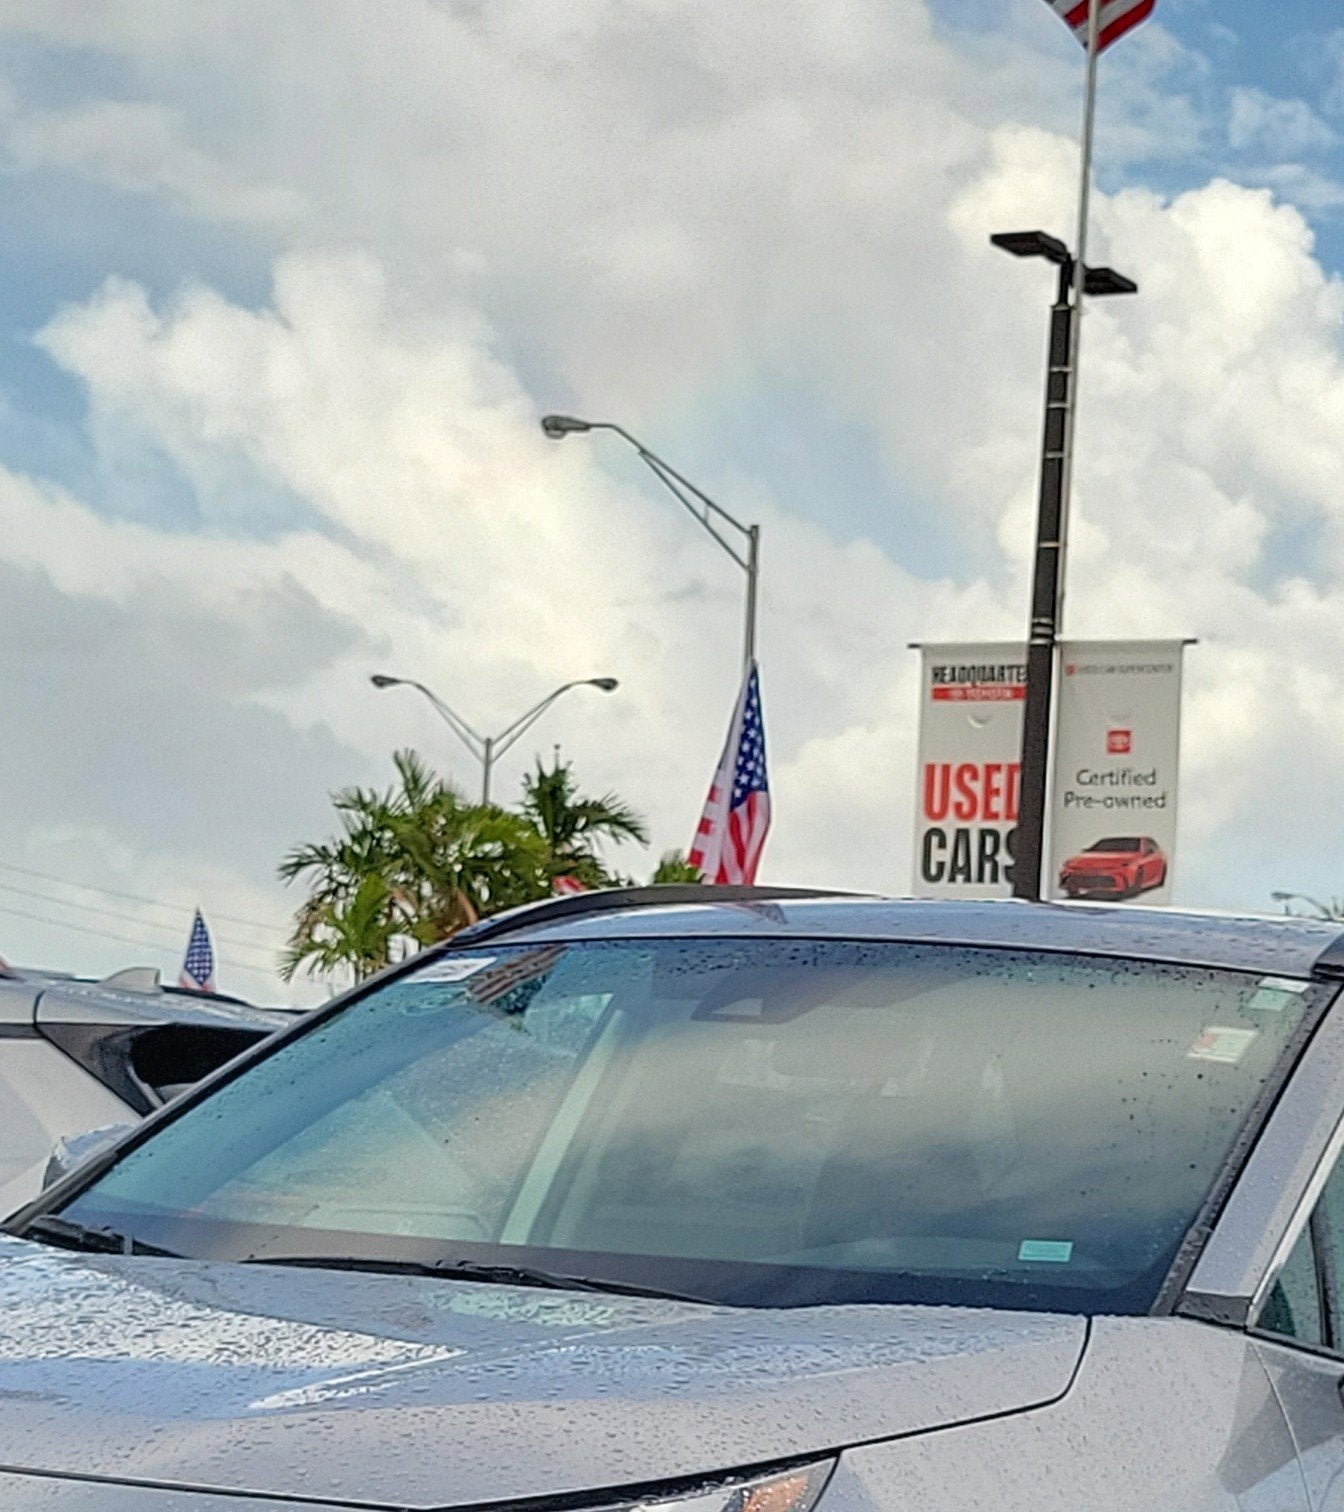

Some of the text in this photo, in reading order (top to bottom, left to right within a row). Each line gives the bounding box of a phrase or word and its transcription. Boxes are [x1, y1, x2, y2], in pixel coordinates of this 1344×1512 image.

[932, 664, 1027, 683] HEADQUARTE
[1076, 768, 1157, 787] Certified
[1064, 791, 1167, 810] Pre-owned
